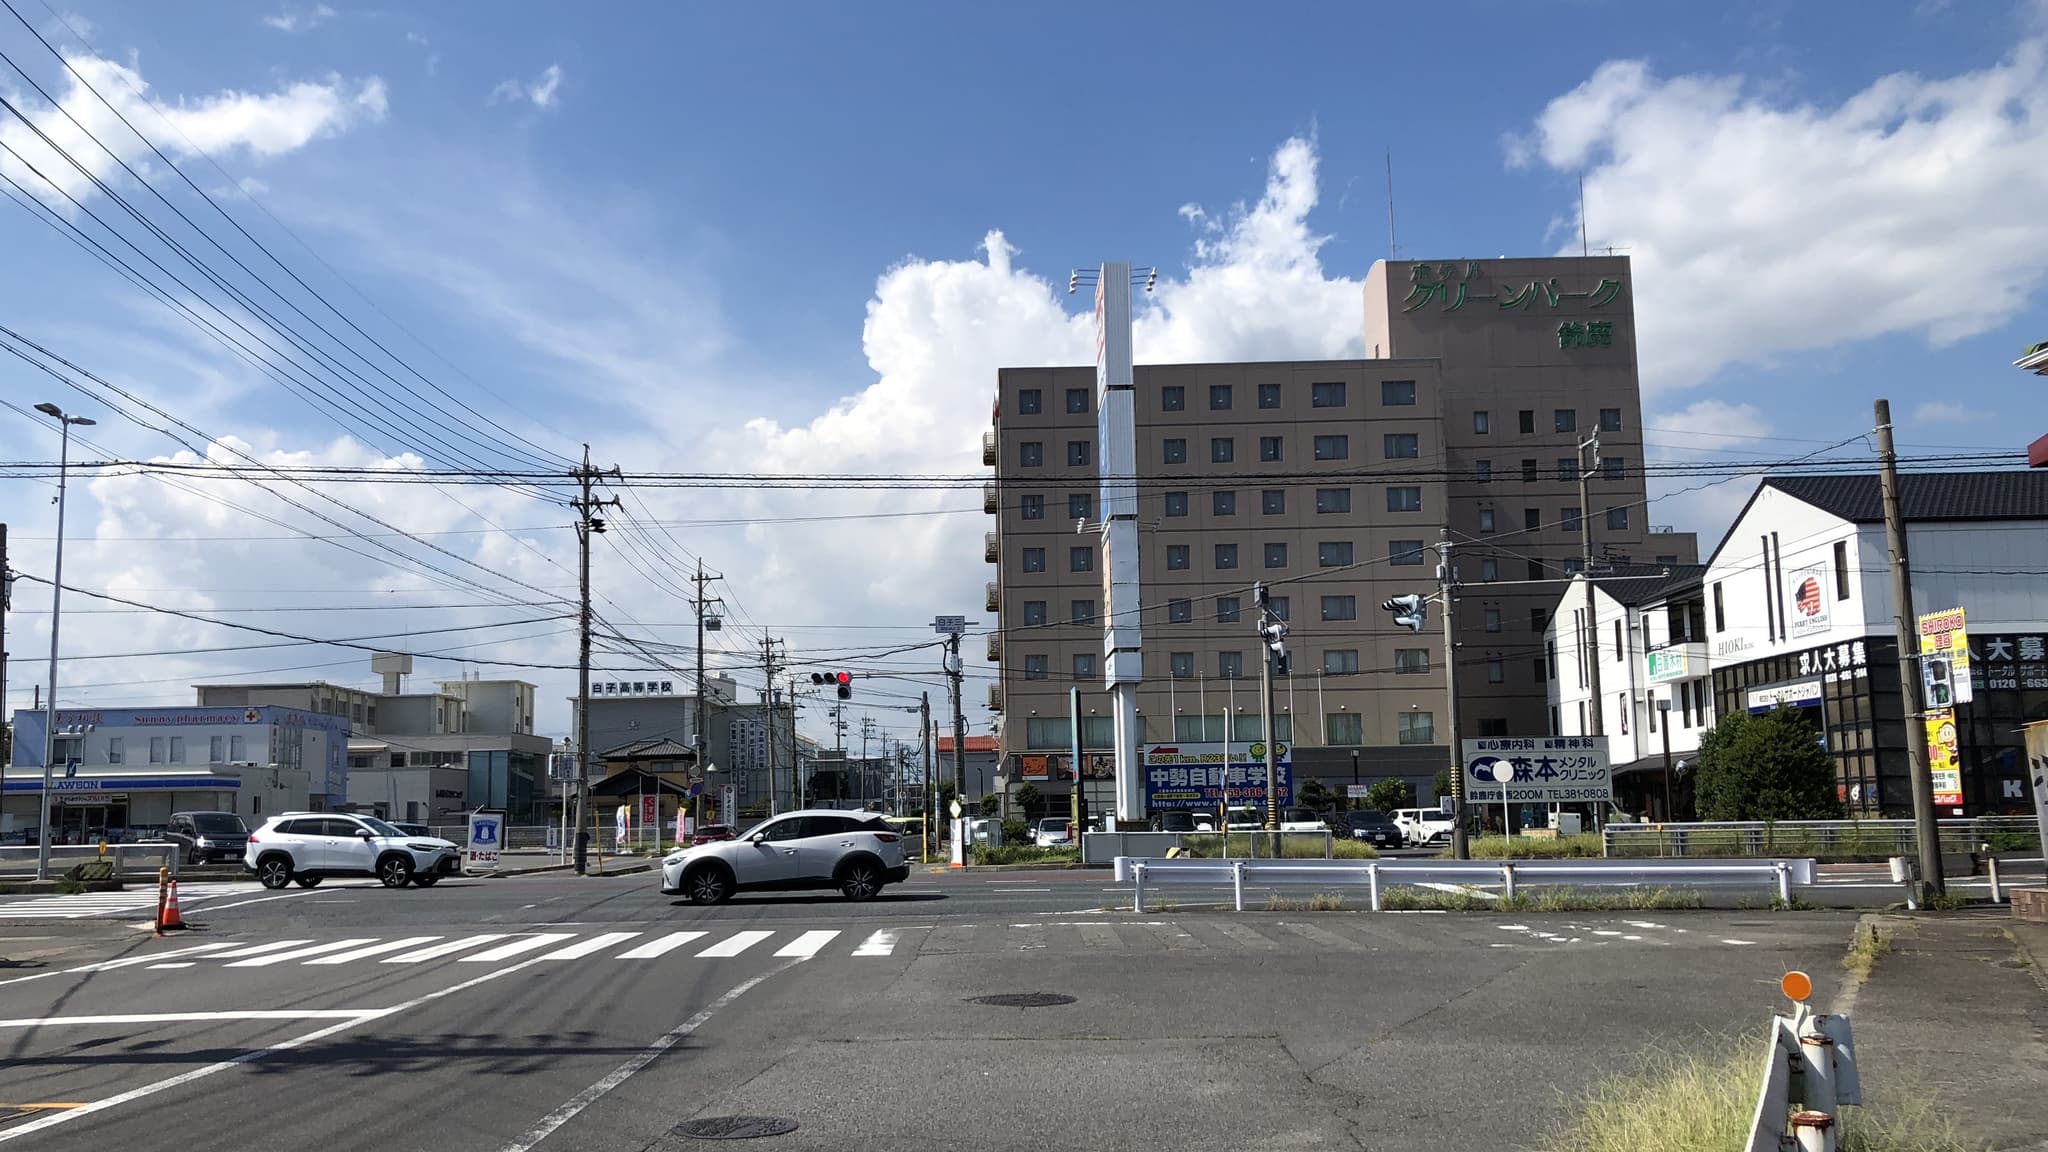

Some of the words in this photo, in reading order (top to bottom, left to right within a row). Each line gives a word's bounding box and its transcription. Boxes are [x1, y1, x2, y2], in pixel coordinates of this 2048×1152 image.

[1410, 263, 1483, 281] ホテル
[1556, 320, 1613, 350] 鈴鹿
[1921, 614, 1964, 636] SHIROKO
[1718, 637, 1743, 656] HIOKI
[1800, 641, 1866, 676] 求人大募集
[592, 681, 673, 693] 白子高等学校
[1487, 739, 1535, 750] 心療内科
[1554, 738, 1594, 749] 精神科
[1150, 767, 1286, 787] 中勢自動車学校
[1509, 756, 1560, 782] 森本
[1559, 756, 1597, 768] メンタル
[1559, 769, 1606, 781] クリニック
